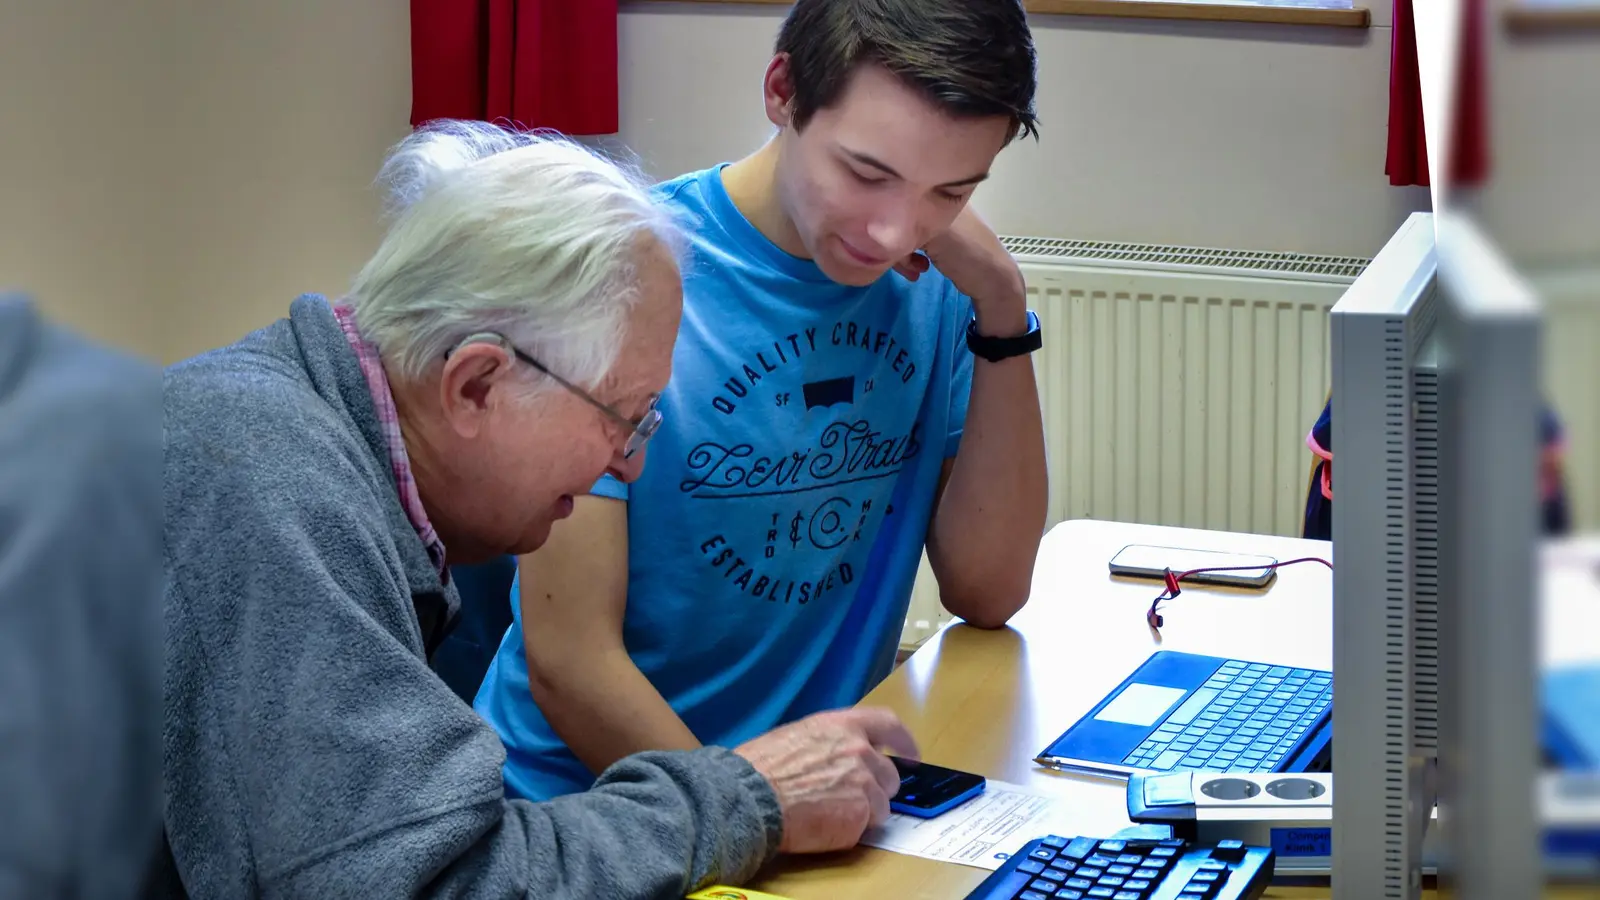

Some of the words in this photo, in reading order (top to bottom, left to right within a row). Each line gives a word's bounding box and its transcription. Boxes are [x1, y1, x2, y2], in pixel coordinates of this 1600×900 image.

[712, 328, 816, 415] QUALITY
[831, 321, 916, 383] CRAFTED
[775, 393, 790, 407] SF
[700, 534, 854, 605] ESTABLISHED
